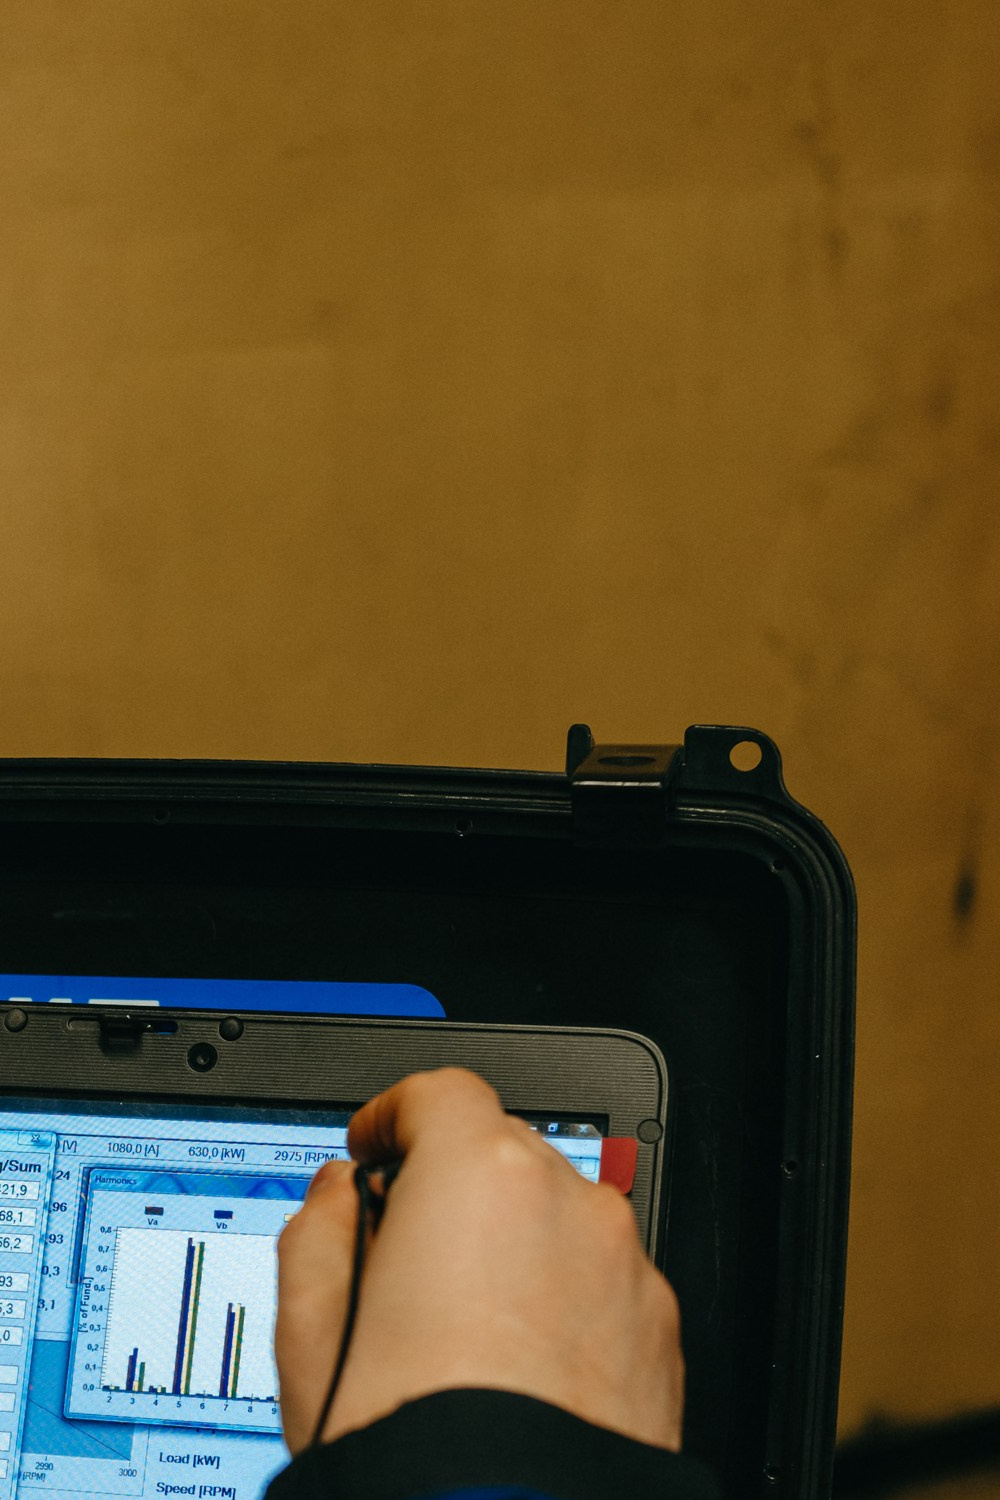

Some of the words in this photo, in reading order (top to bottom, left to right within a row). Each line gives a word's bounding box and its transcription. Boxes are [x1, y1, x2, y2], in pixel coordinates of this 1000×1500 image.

[107, 1142, 142, 1156] 1080,0
[144, 1144, 160, 1157] [A]
[188, 1146, 219, 1159] 630,0
[220, 1147, 246, 1161] [kW]
[274, 1150, 302, 1162] 2975
[95, 1175, 138, 1186] Harmonics
[147, 1218, 159, 1226] Va
[216, 1221, 228, 1230] Vb
[100, 1226, 112, 1235] 0,8
[98, 1245, 110, 1254] 0,7
[95, 1264, 108, 1273] 0,6
[93, 1284, 106, 1293] 0,5
[87, 1343, 99, 1352] 0,2
[85, 1363, 96, 1372] 0,1
[82, 1383, 95, 1392] 0,0
[159, 1452, 189, 1464] Load
[192, 1453, 220, 1469] [kW]
[35, 1461, 54, 1471] 2990
[22, 1472, 45, 1482] [RPM]
[118, 1468, 137, 1478] 3000
[156, 1482, 195, 1496] Speed
[198, 1485, 236, 1500] [RPM]
